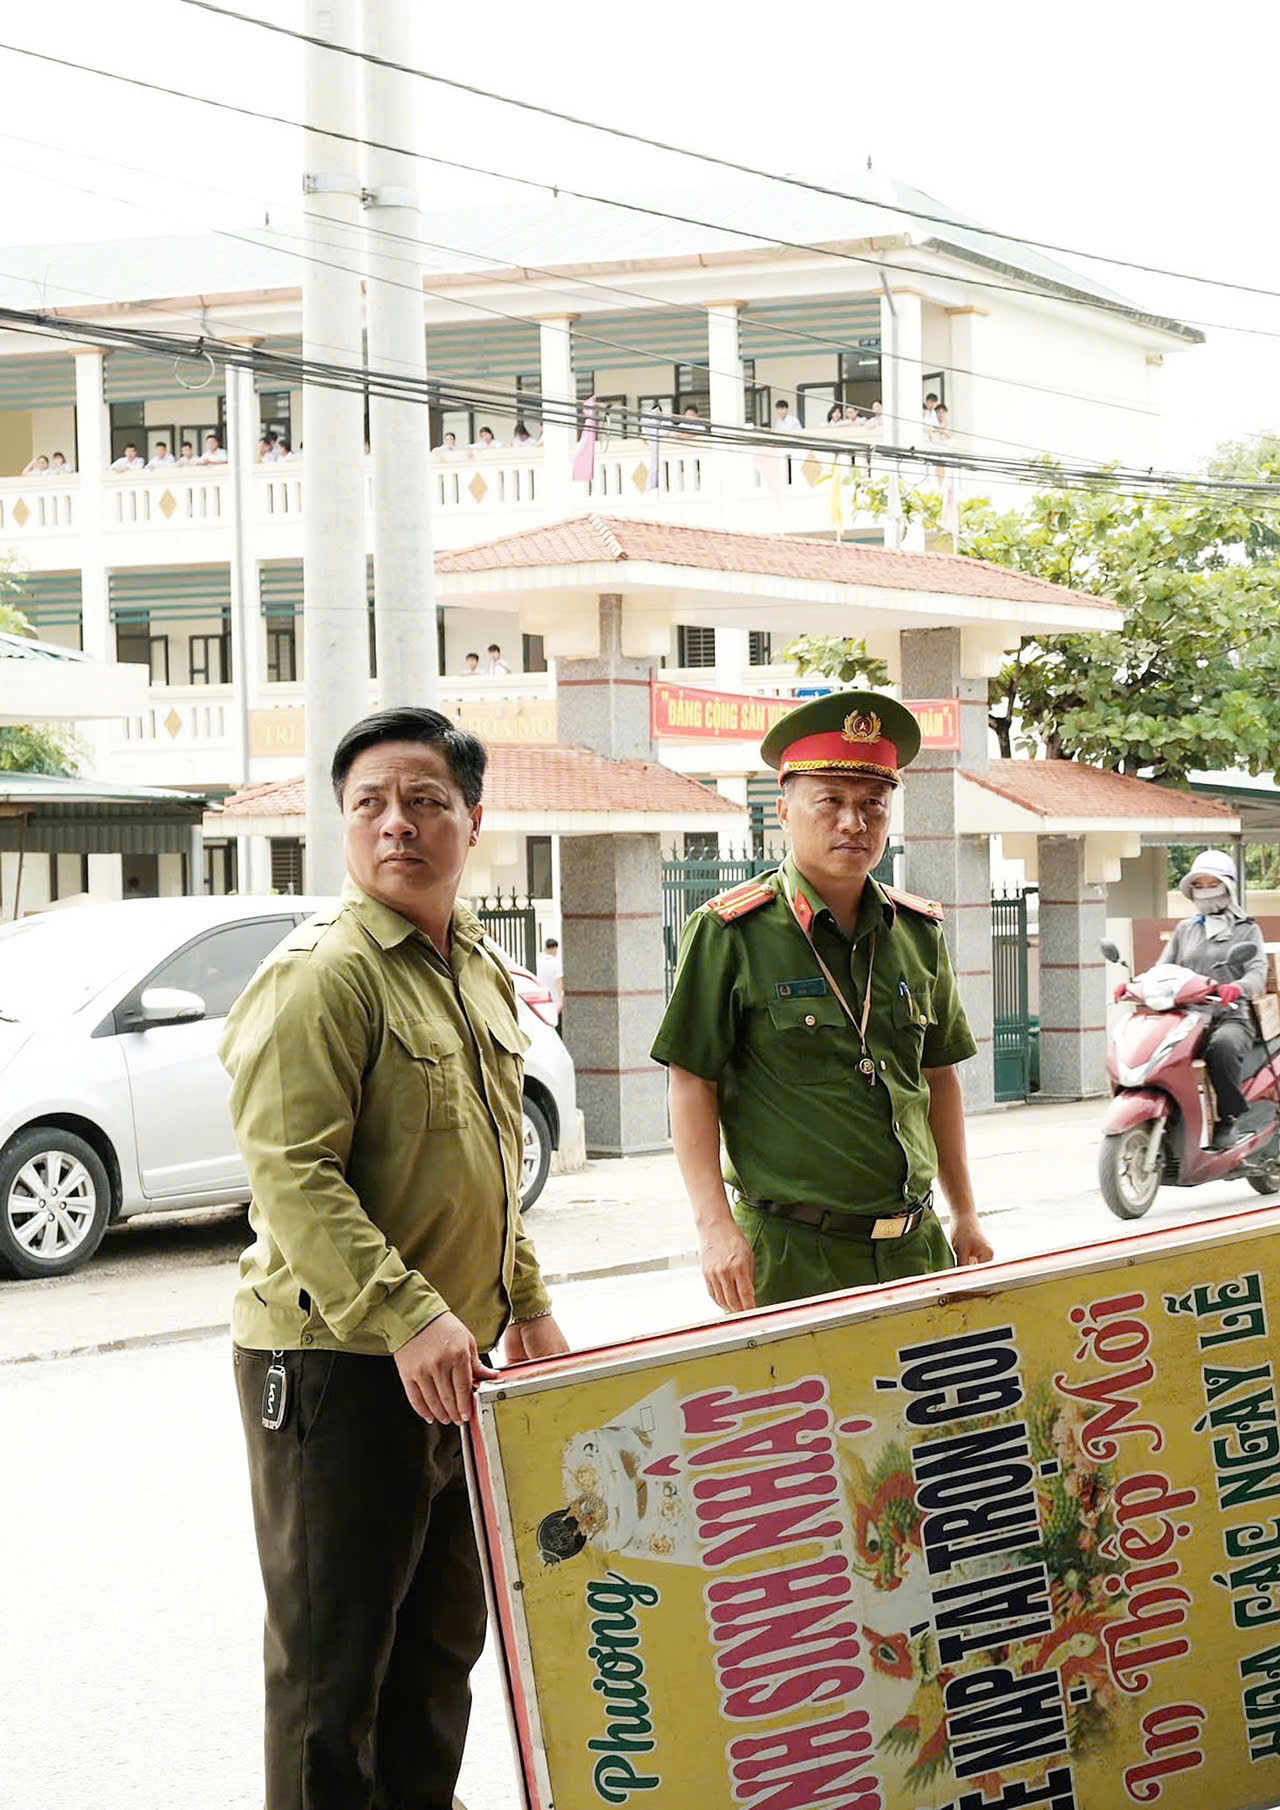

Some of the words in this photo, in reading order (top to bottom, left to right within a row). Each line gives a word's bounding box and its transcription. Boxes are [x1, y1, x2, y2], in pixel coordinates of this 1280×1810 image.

[705, 697, 738, 735] CỘNG
[876, 1327, 1023, 1425] GÓI
[1055, 1294, 1161, 1459] Mời
[1165, 1275, 1266, 1348] LỄ
[643, 1380, 873, 1567] NHẬT
[912, 1423, 1058, 1575] TRỌN
[707, 1555, 864, 1718] SINH
[911, 1564, 1052, 1664] TÀI
[1101, 1474, 1195, 1692] Thiệp
[587, 1571, 659, 1804] Phương
[945, 1669, 1088, 1778] NẠP
[1126, 1704, 1204, 1801] In
